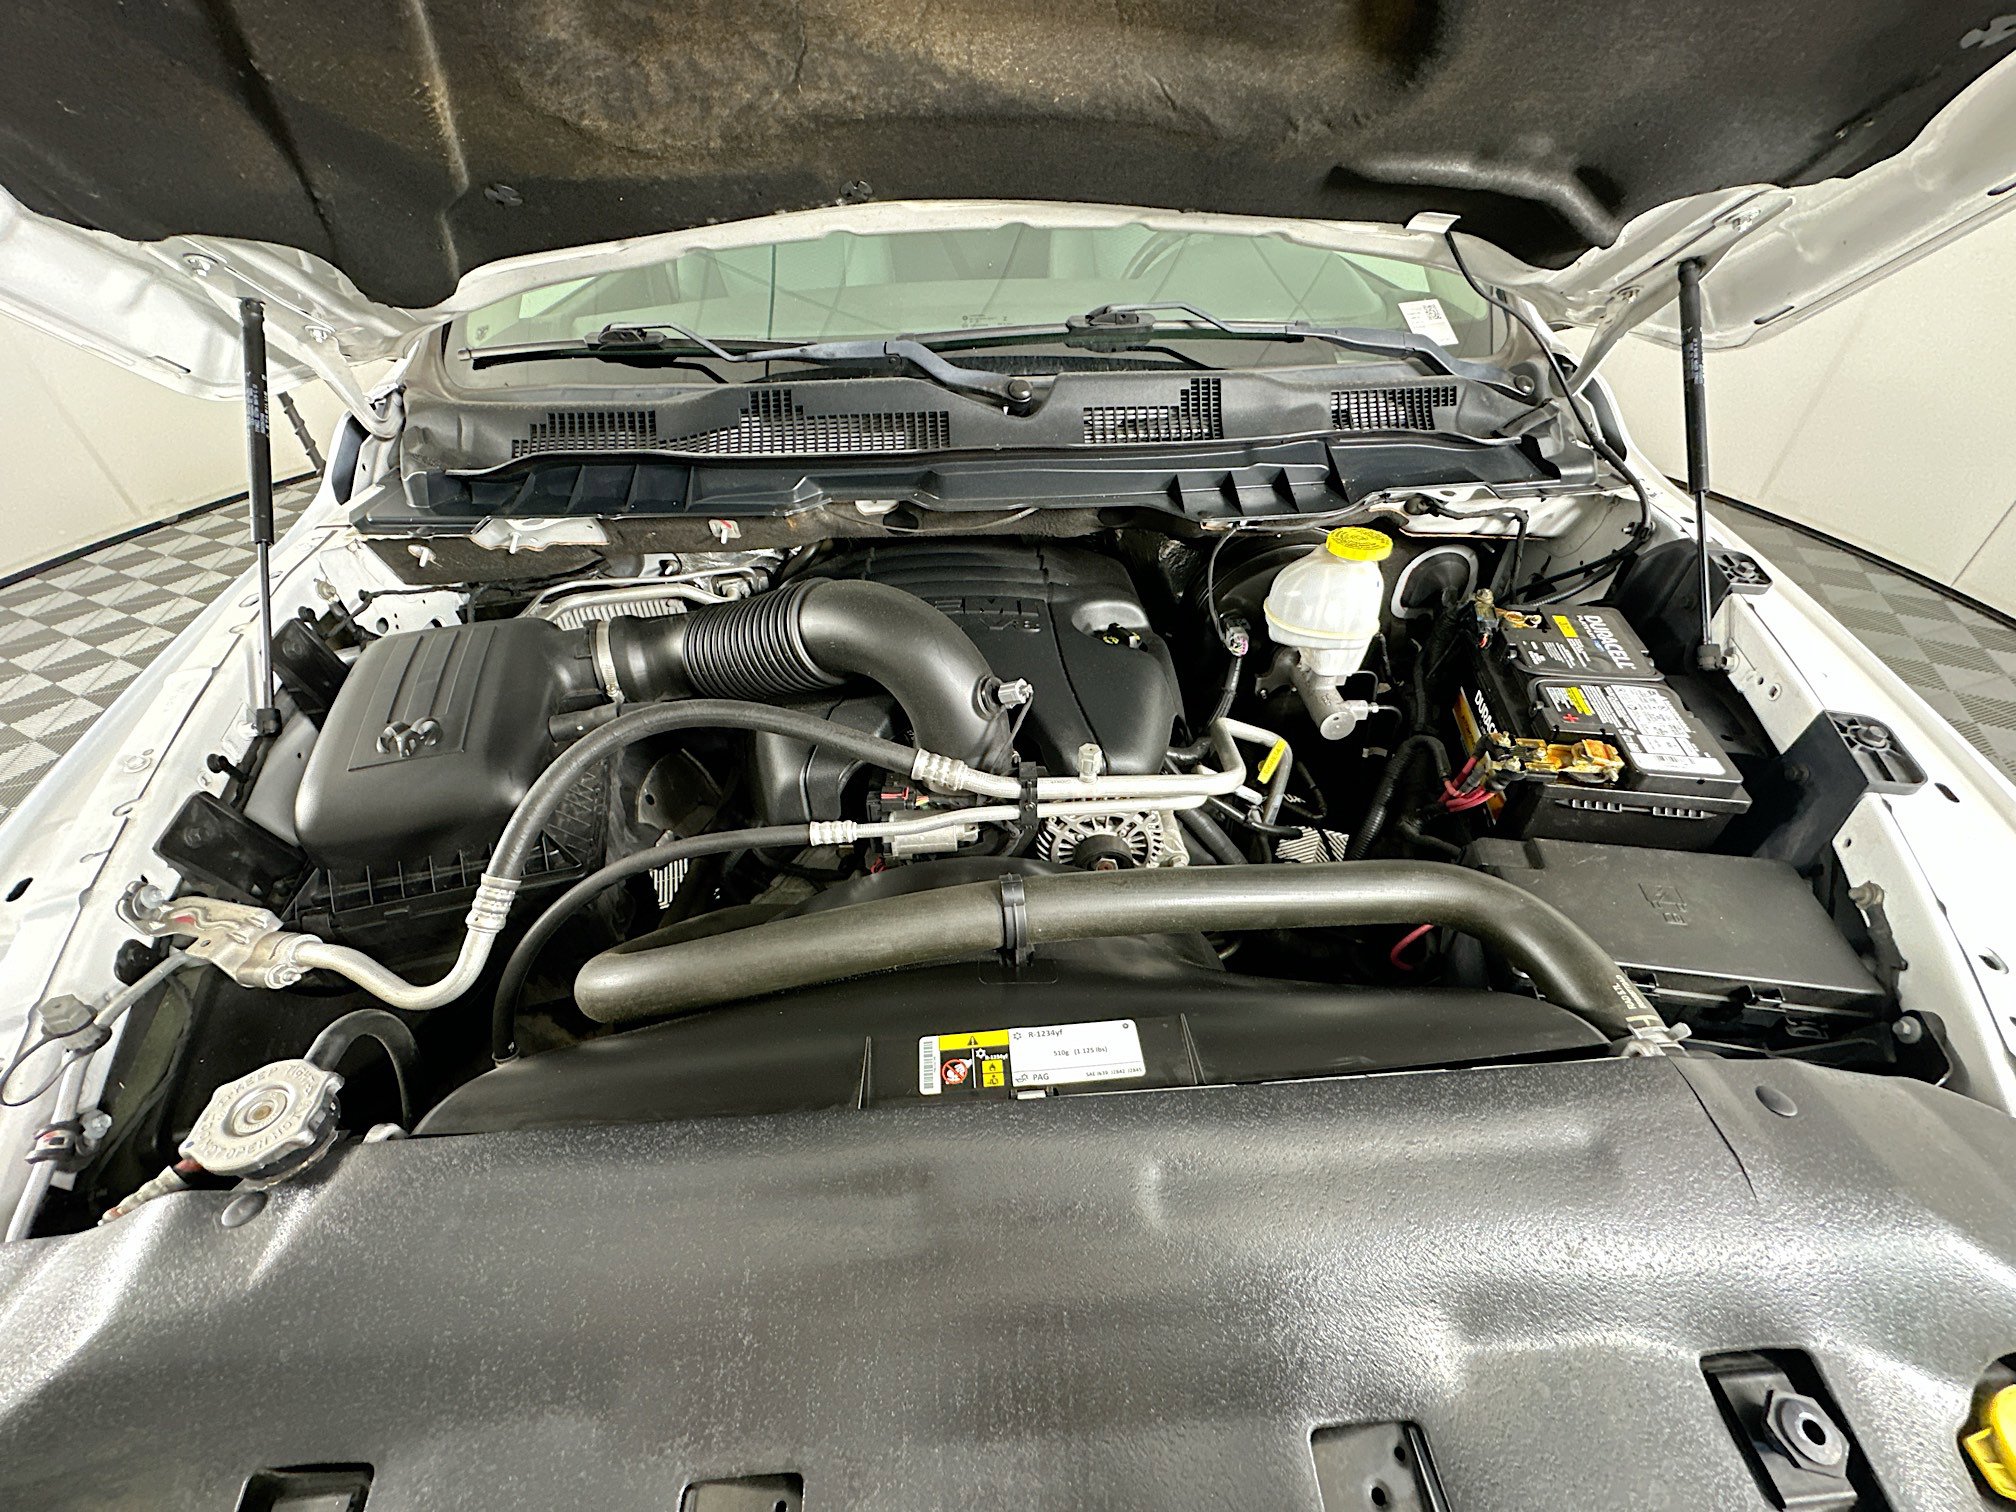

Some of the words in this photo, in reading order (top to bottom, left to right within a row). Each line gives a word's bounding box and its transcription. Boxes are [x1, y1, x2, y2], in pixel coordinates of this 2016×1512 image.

[1583, 615, 1635, 669] DURACELL
[1474, 690, 1499, 733] DURAC
[1028, 1029, 1063, 1038] R-1234yf
[1053, 1049, 1070, 1057] 510g
[1095, 1046, 1108, 1054] lbs)
[233, 1066, 279, 1093] KEEP
[1032, 1072, 1050, 1081] PAG
